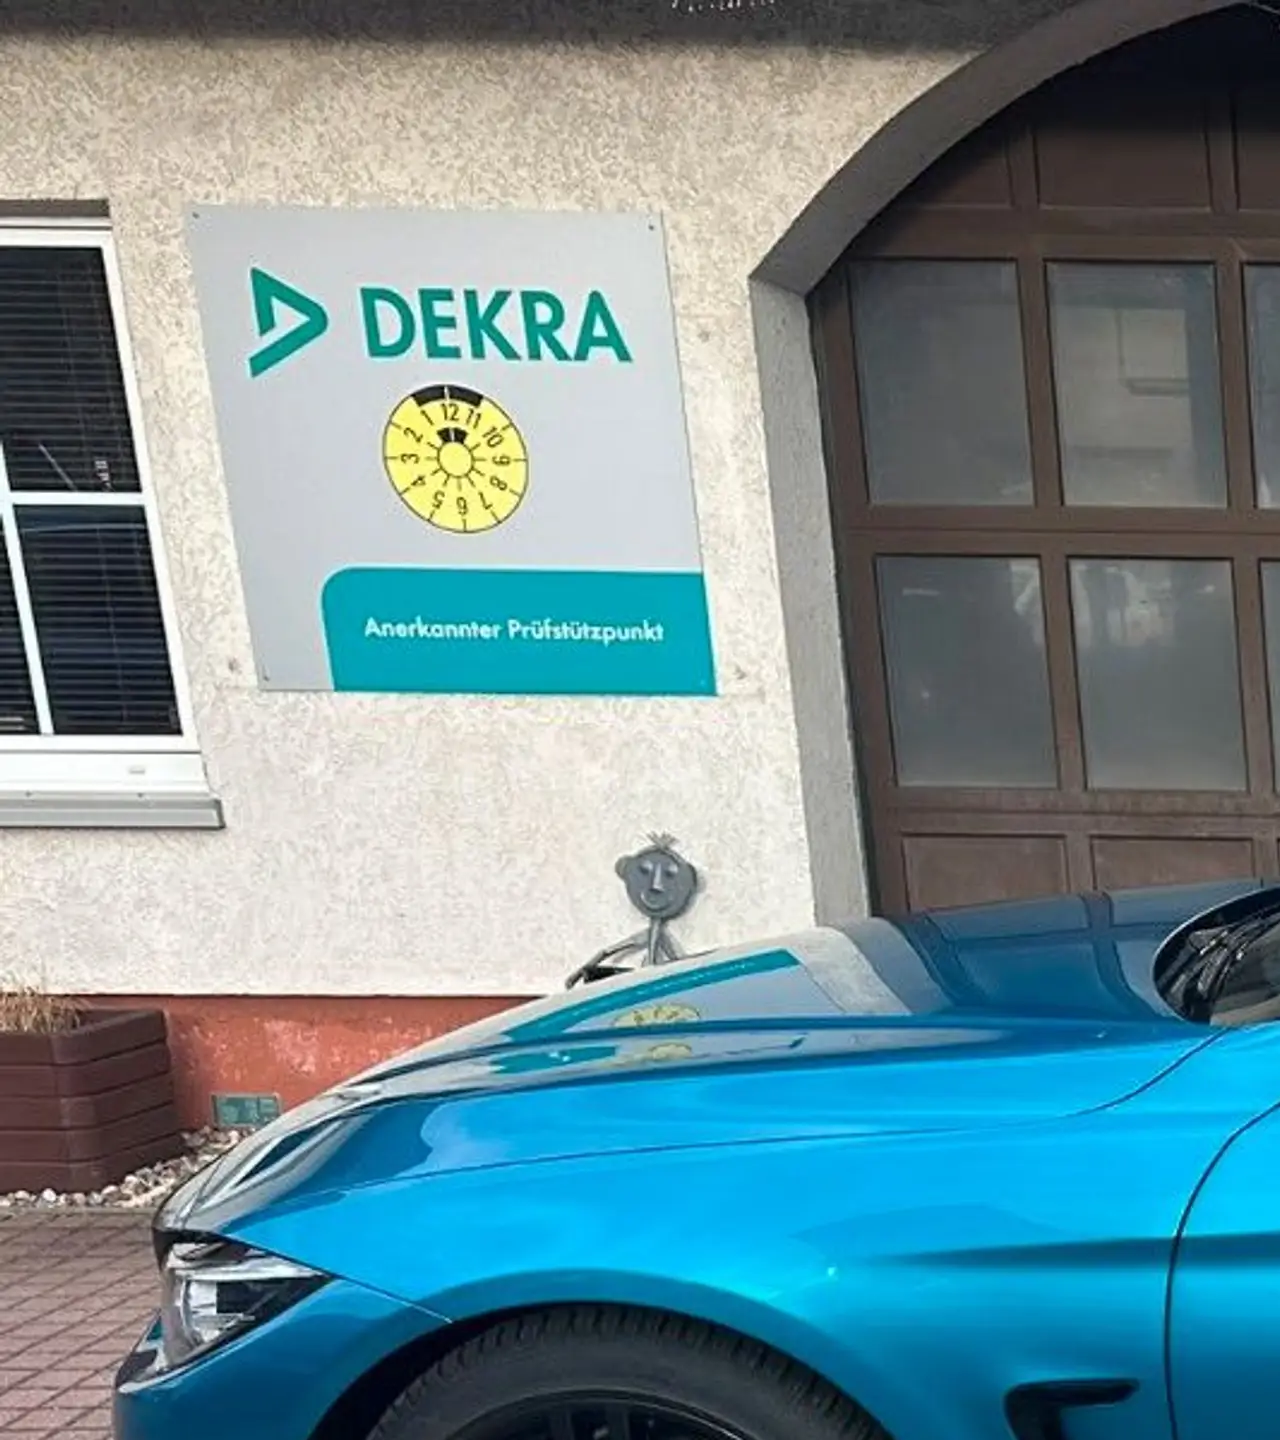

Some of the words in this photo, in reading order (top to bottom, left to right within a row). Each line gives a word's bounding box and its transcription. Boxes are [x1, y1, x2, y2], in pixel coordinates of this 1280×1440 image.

[360, 287, 633, 362] DEKRA
[420, 409, 434, 426] 1
[440, 402, 460, 421] 12
[465, 408, 482, 429] 11
[403, 427, 424, 443] 2
[482, 426, 505, 448] 10
[400, 453, 420, 465] 3
[410, 475, 426, 486] 4
[489, 475, 508, 491] 8
[431, 491, 445, 509] 5
[478, 492, 492, 510] 7
[364, 615, 501, 639] Anerkannter
[507, 616, 665, 646] Prüfstützpunkt
